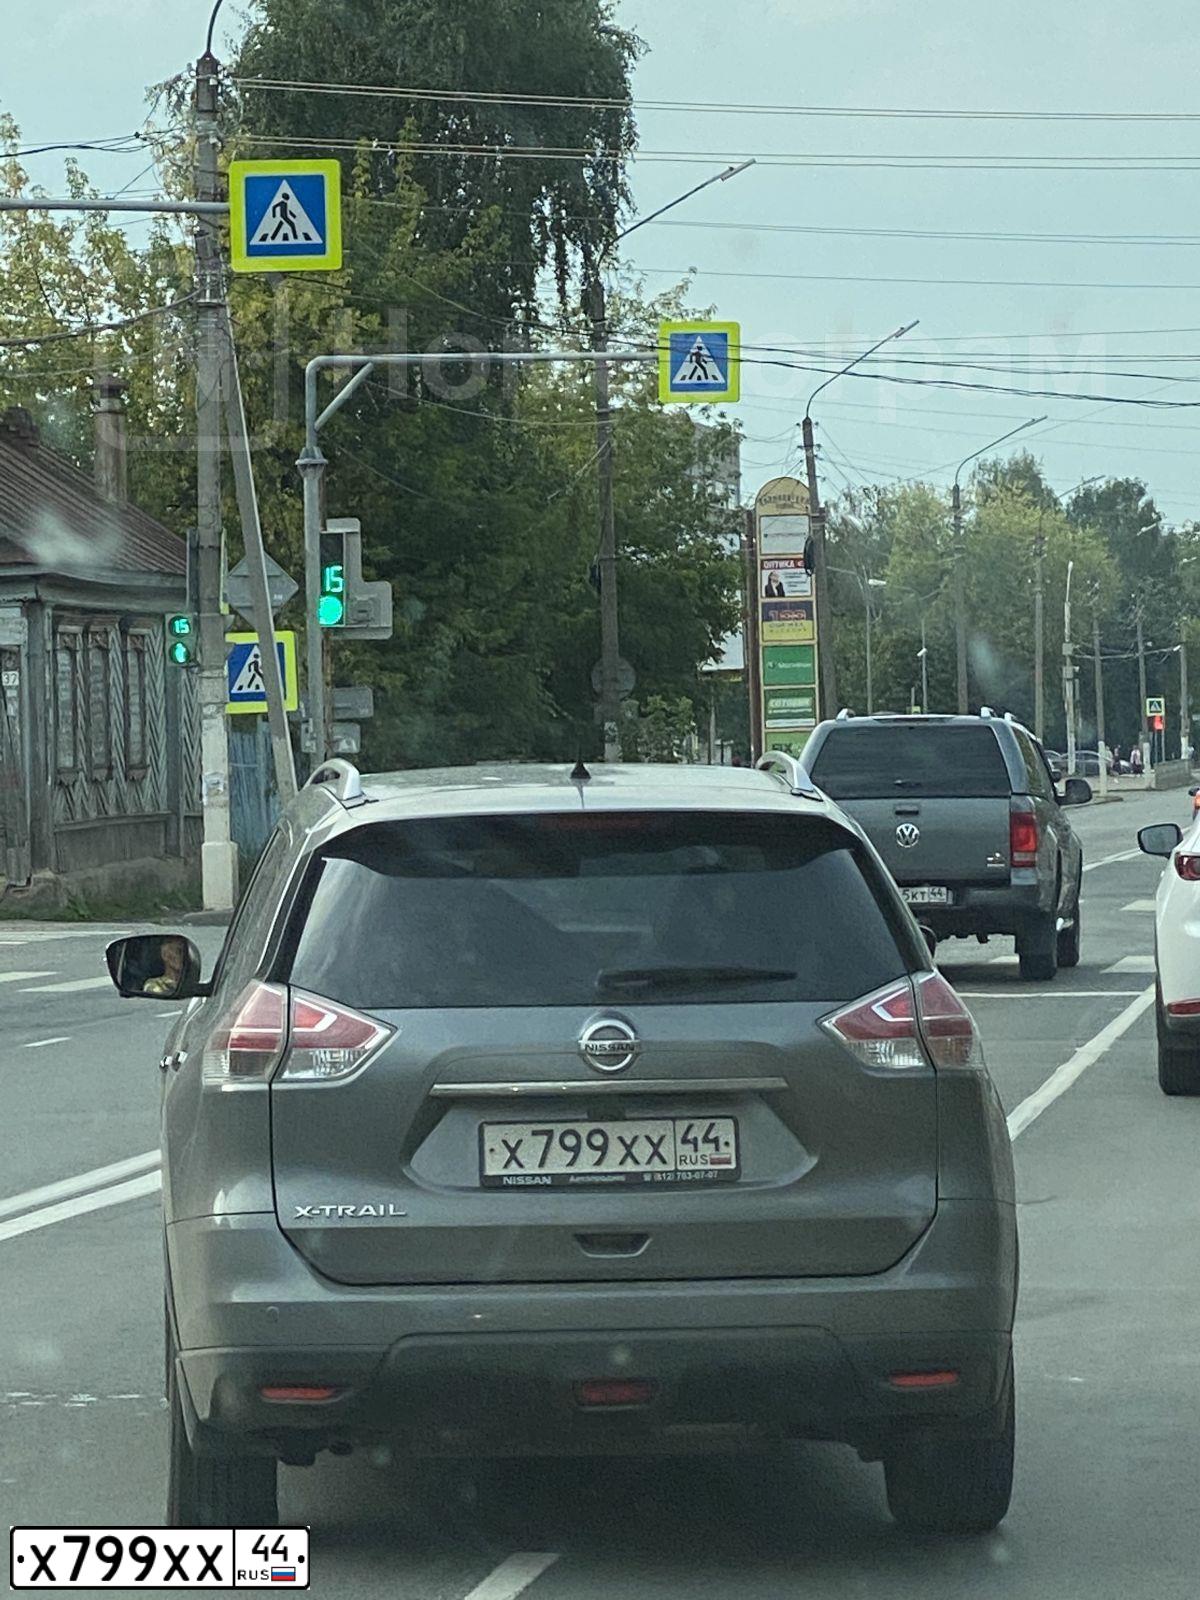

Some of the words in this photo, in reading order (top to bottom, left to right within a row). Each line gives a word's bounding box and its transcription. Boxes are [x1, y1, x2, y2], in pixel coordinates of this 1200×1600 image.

[325, 565, 343, 593] 15
[174, 618, 190, 634] 15
[3, 673, 17, 685] 37
[584, 1043, 635, 1052] NISSAN
[680, 1123, 720, 1153] 44
[679, 1154, 709, 1166] RUS
[502, 1176, 552, 1185] NISSAN
[294, 1203, 408, 1219] X-TRAIL
